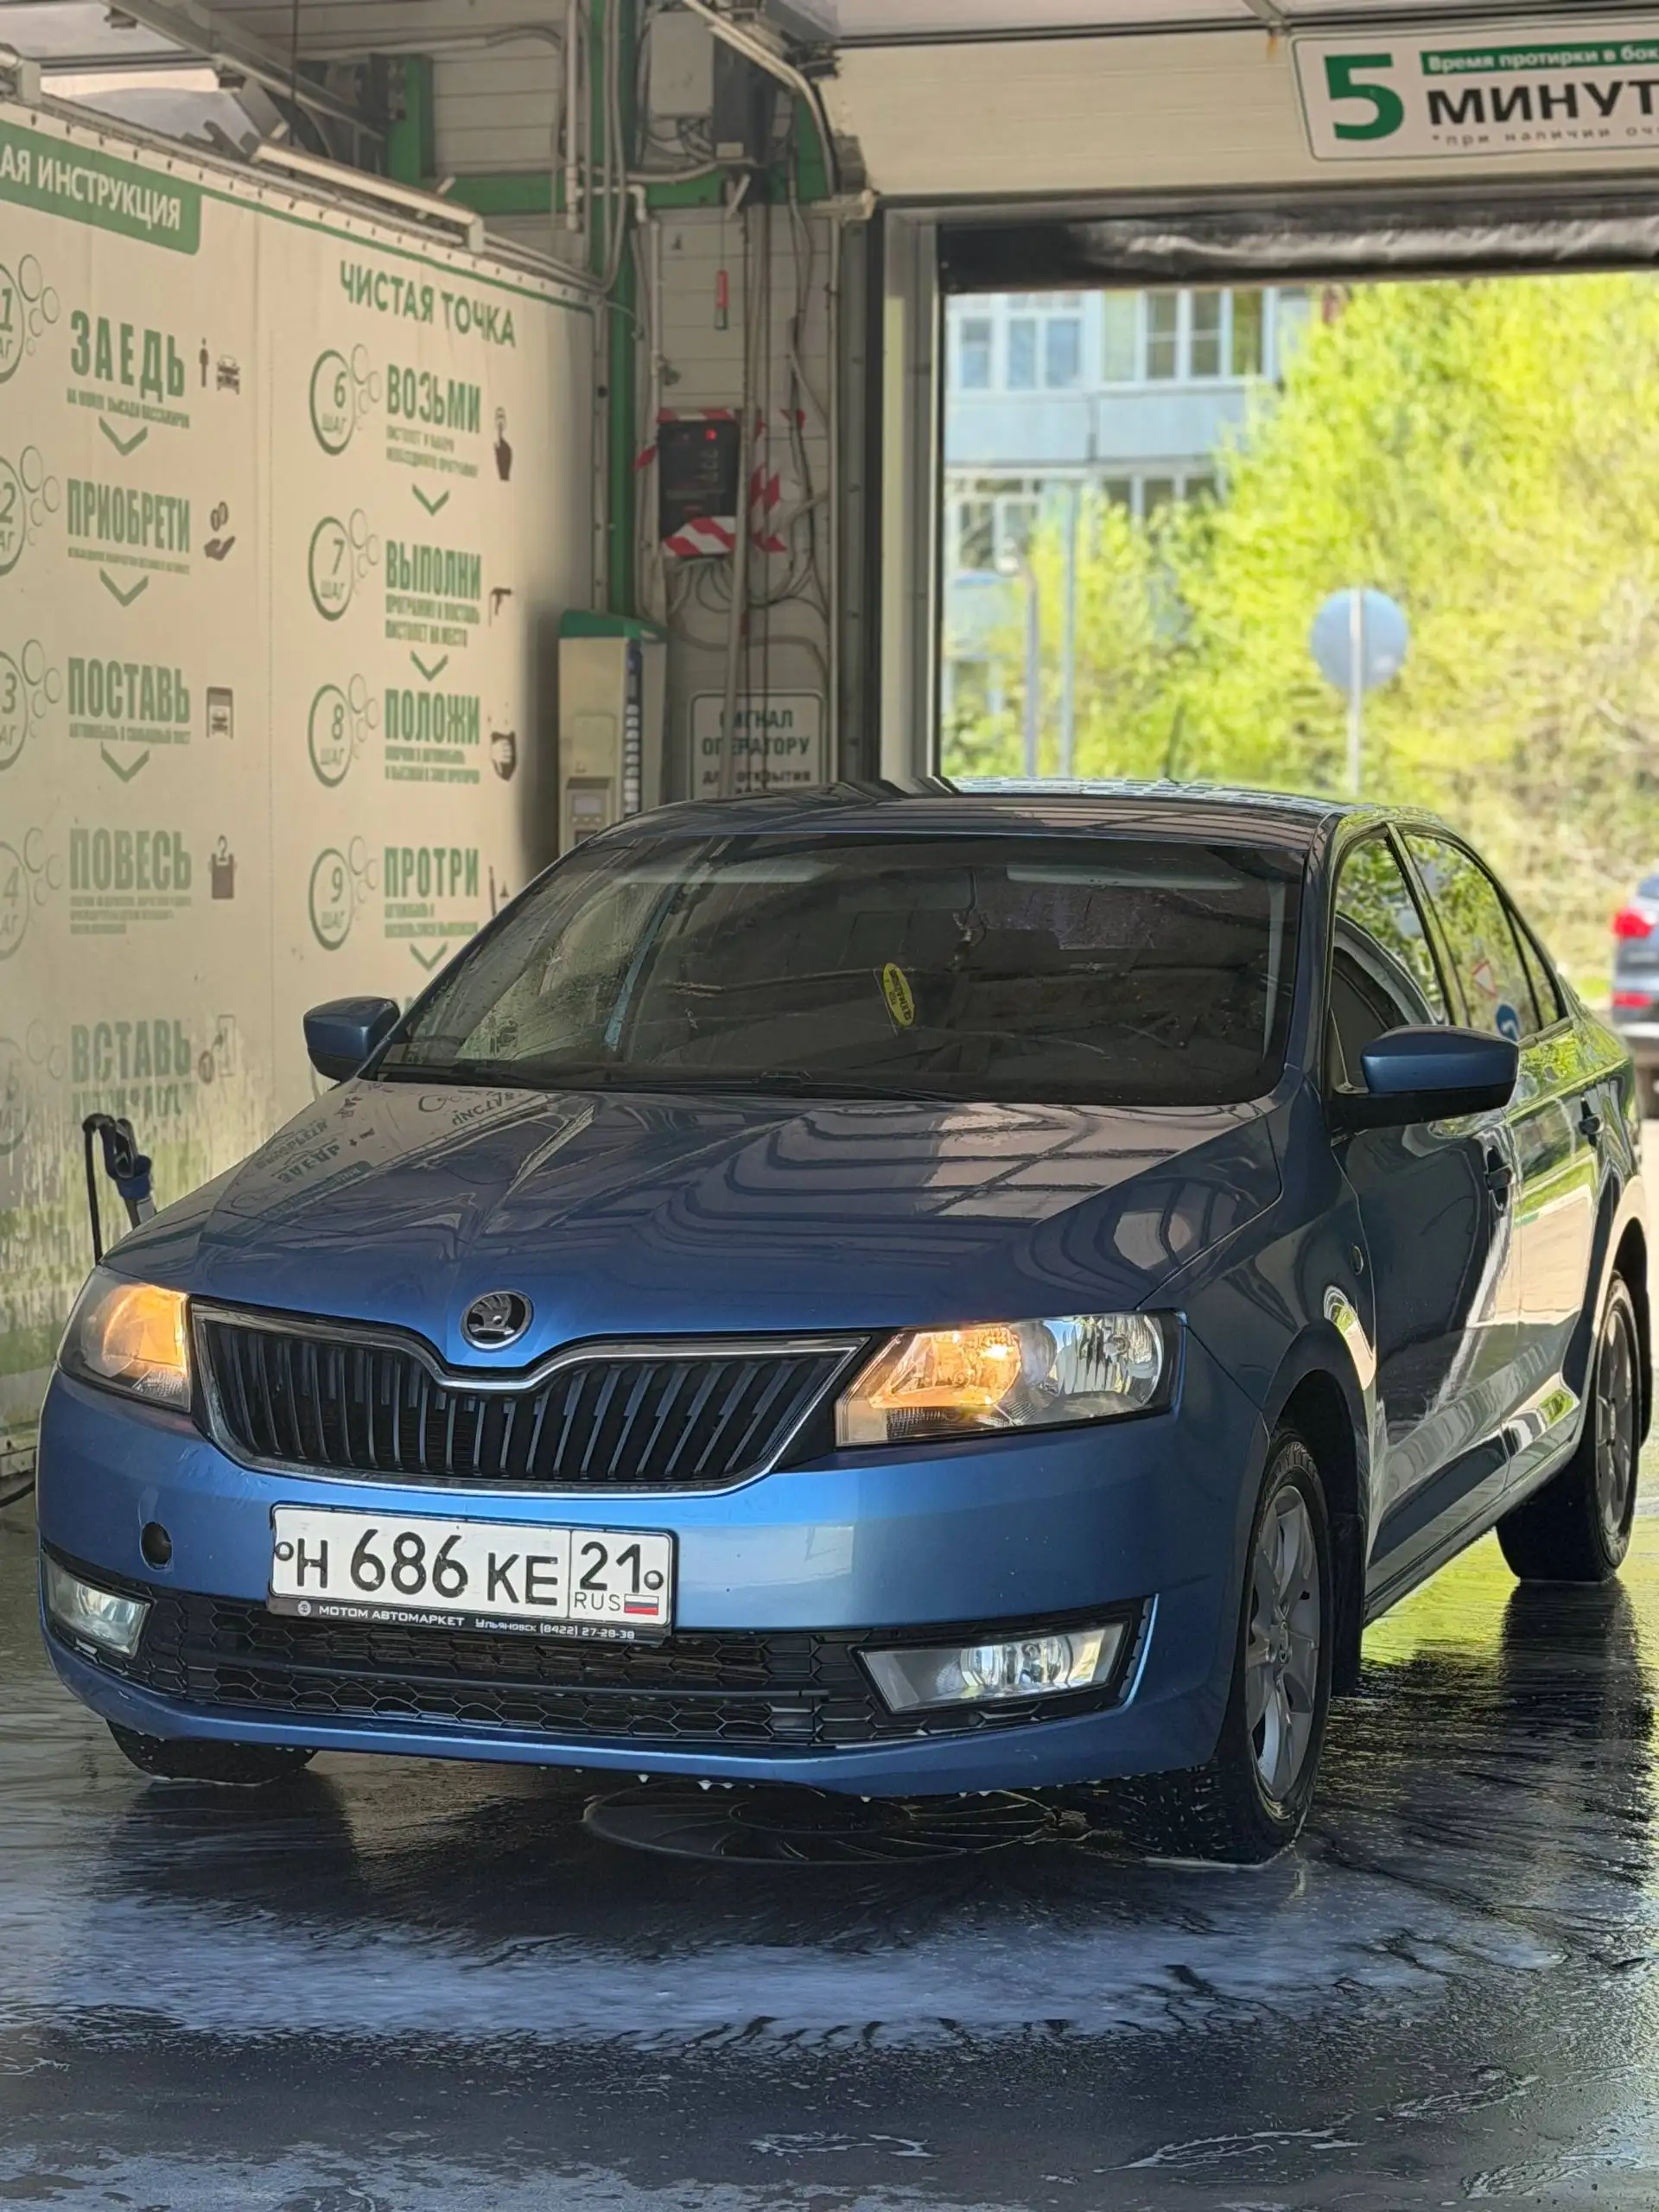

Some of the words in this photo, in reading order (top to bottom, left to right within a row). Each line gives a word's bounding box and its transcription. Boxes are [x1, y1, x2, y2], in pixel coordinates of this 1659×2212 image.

[1428, 54, 1494, 73] Время
[1500, 50, 1598, 70] протирки
[1603, 49, 1617, 62] в
[1324, 54, 1405, 140] 5
[1427, 79, 1659, 126] МИНУТ
[1625, 126, 1659, 137] оч
[37, 155, 181, 231] ИНСТРУКЦИЯ
[340, 260, 434, 325] ЧИСТАЯ
[441, 290, 516, 348] ТОЧКА
[71, 309, 185, 404] ЗАЕДЬ
[334, 372, 346, 409] 6
[388, 364, 480, 434] ВОЗЬМИ
[322, 413, 346, 435] ШАГ
[0, 481, 16, 524] 2
[67, 478, 190, 553] ПРИОБРЕТИ
[333, 537, 345, 575] 7
[386, 539, 481, 602] ВЫПОЛНИ
[321, 580, 346, 601] ШАГ
[2, 671, 17, 715] 3
[68, 657, 190, 724] ПОСТАВЬ
[332, 703, 344, 741] 8
[385, 689, 480, 746] ПОЛОЖИ
[321, 747, 345, 766] ШАГ
[70, 828, 192, 891] ПОВЕСЬ
[385, 847, 479, 898] ПРОТРИ
[3, 866, 19, 908] 4
[331, 866, 343, 904] 9
[321, 910, 346, 931] ШАГ
[72, 1019, 191, 1084] ВСТАВЬ
[296, 1538, 327, 1588] Н
[350, 1529, 468, 1599] 686
[487, 1552, 558, 1606] КЕ
[579, 1541, 641, 1594] 21
[318, 1605, 369, 1619] МОТОМ
[372, 1610, 465, 1627] АВТОМАРКЕТ
[539, 1623, 578, 1637] (8422)
[574, 1592, 621, 1611] RUS
